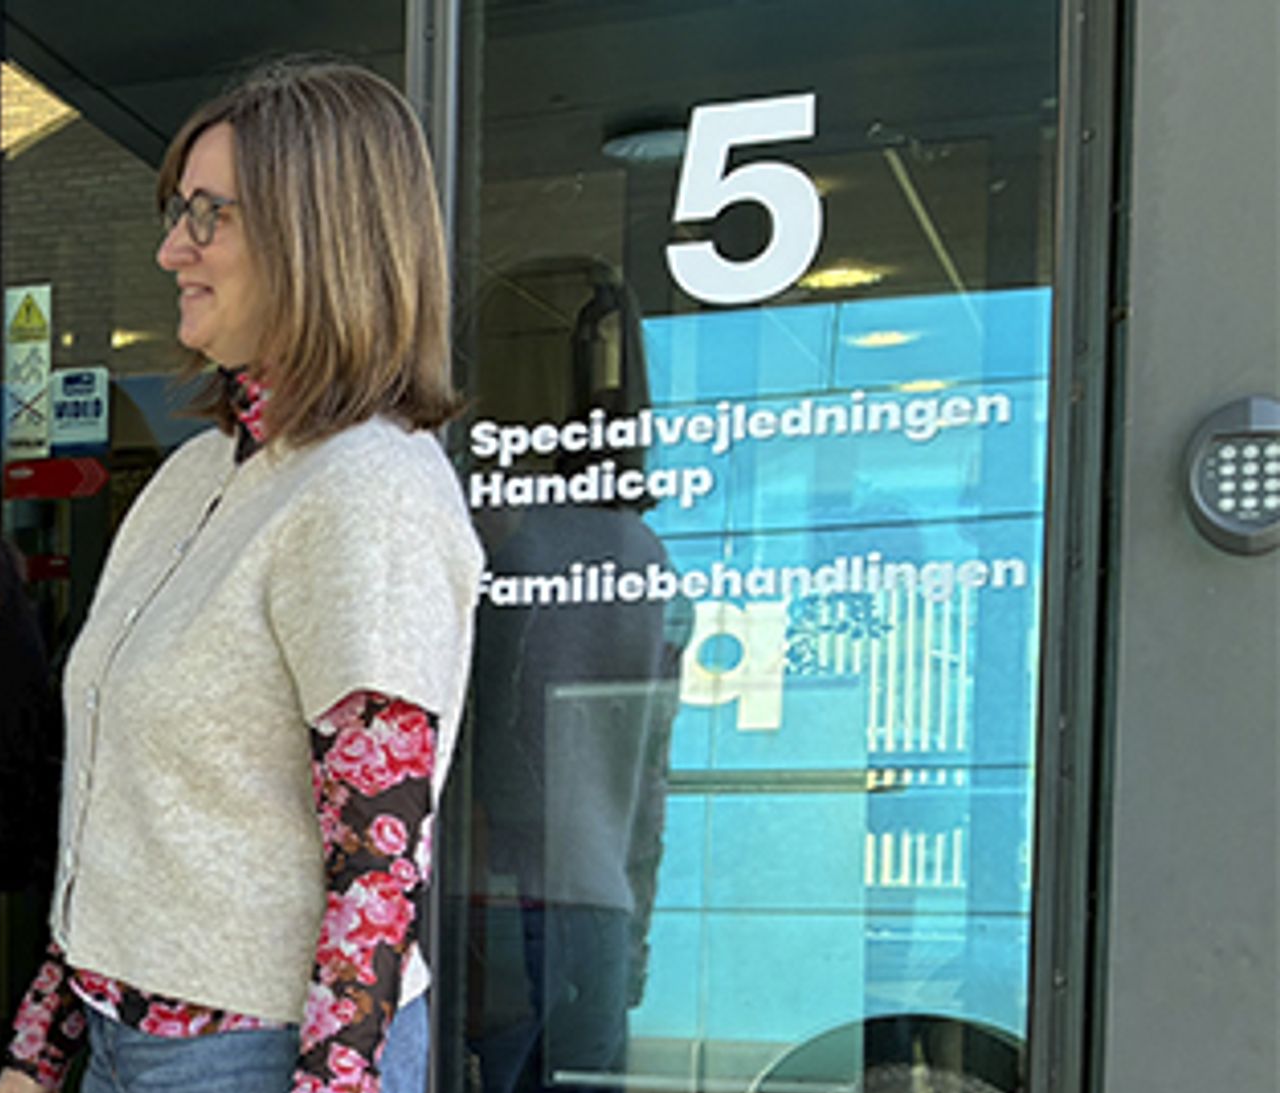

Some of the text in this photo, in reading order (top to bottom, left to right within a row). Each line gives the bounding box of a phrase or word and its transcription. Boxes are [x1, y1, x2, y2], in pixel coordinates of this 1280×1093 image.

[666, 92, 822, 305] 5
[470, 390, 1011, 466] Specialvejledningen
[470, 460, 713, 507] Handicap
